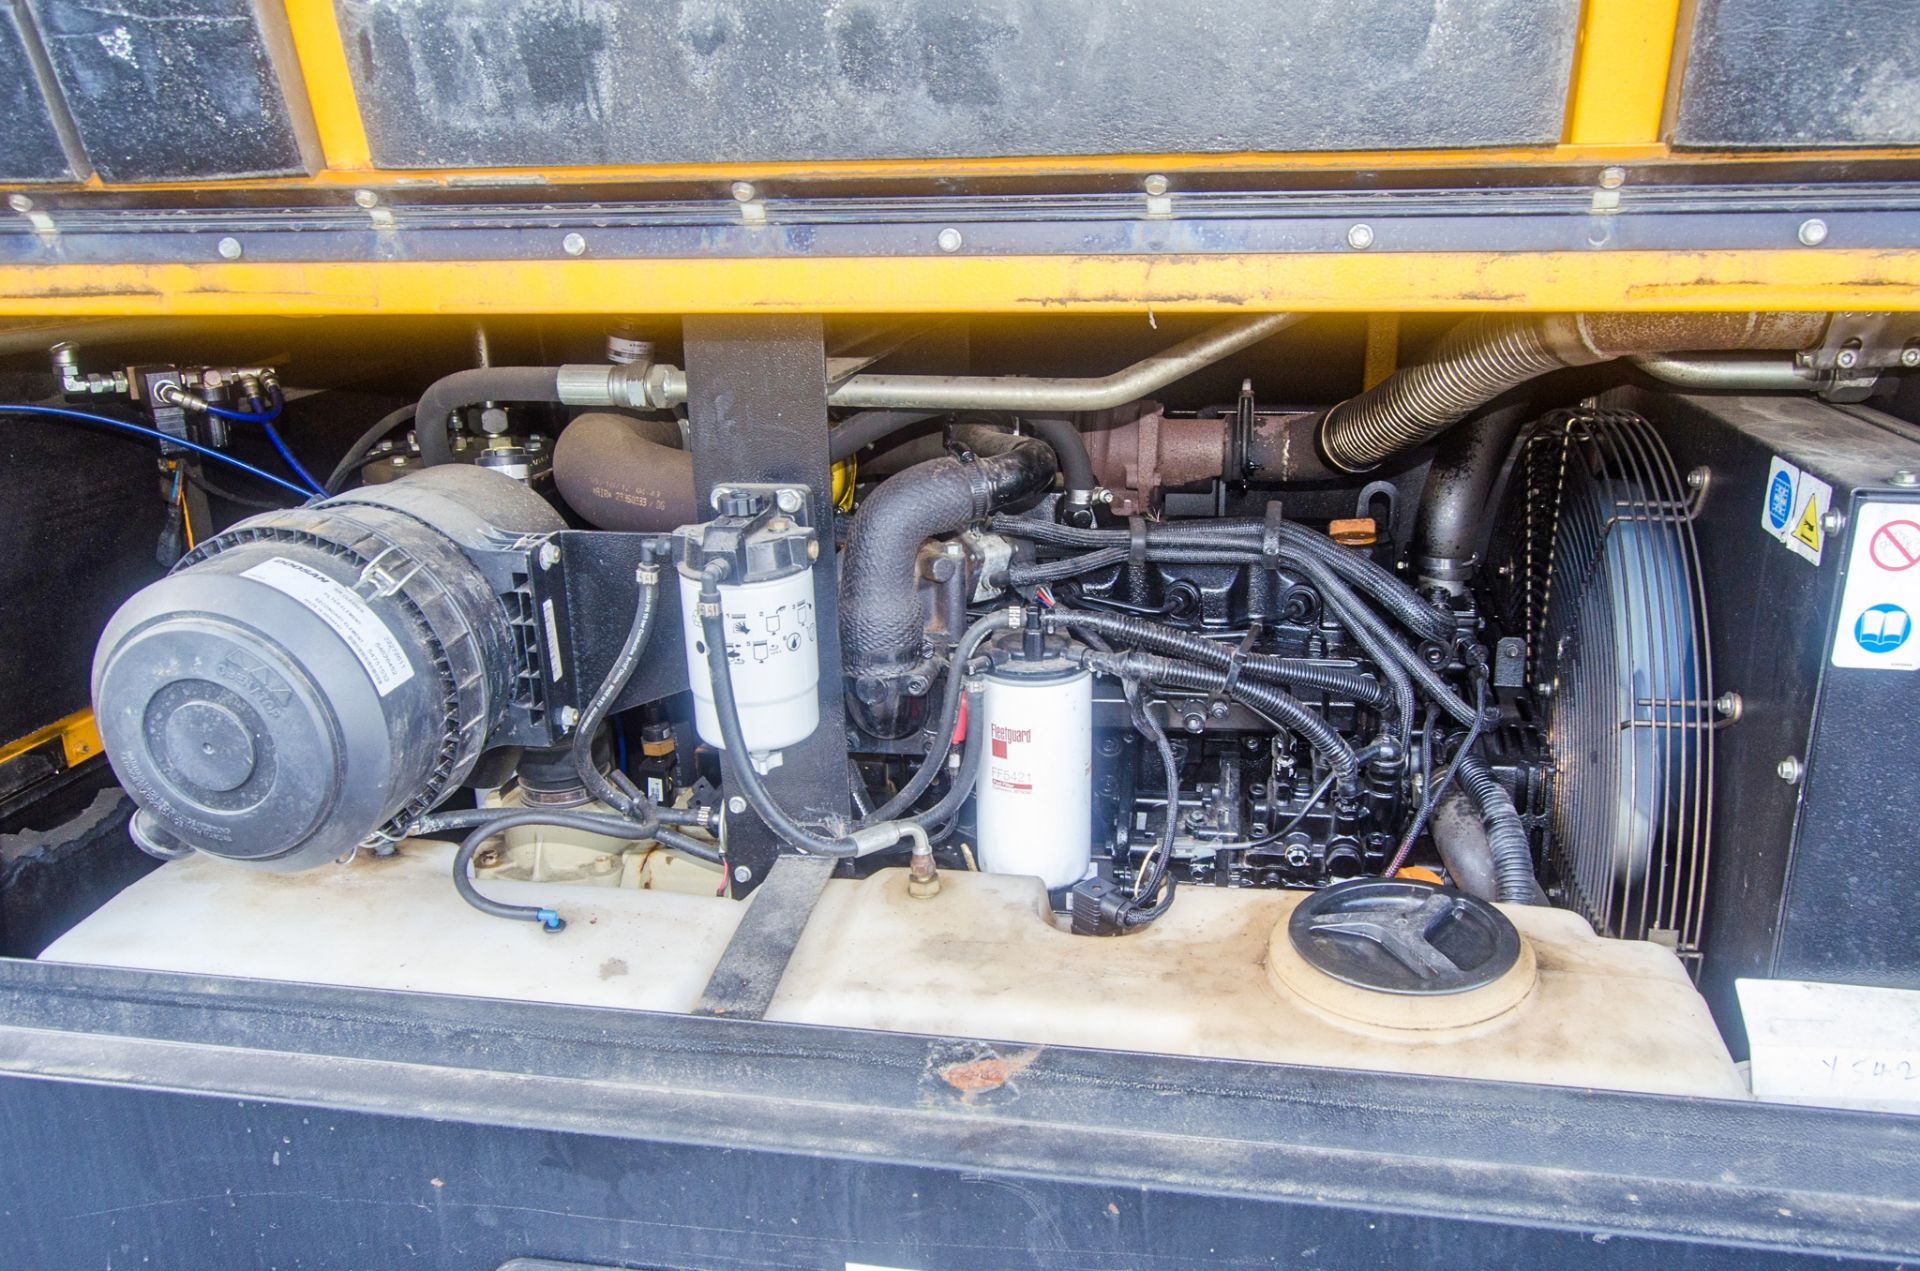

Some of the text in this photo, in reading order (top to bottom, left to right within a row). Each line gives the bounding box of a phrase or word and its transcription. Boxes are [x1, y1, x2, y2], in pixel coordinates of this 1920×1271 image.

[273, 559, 331, 584] DOOSAN
[991, 723, 1032, 744] Fleetguard
[992, 767, 1032, 783] FF5421
